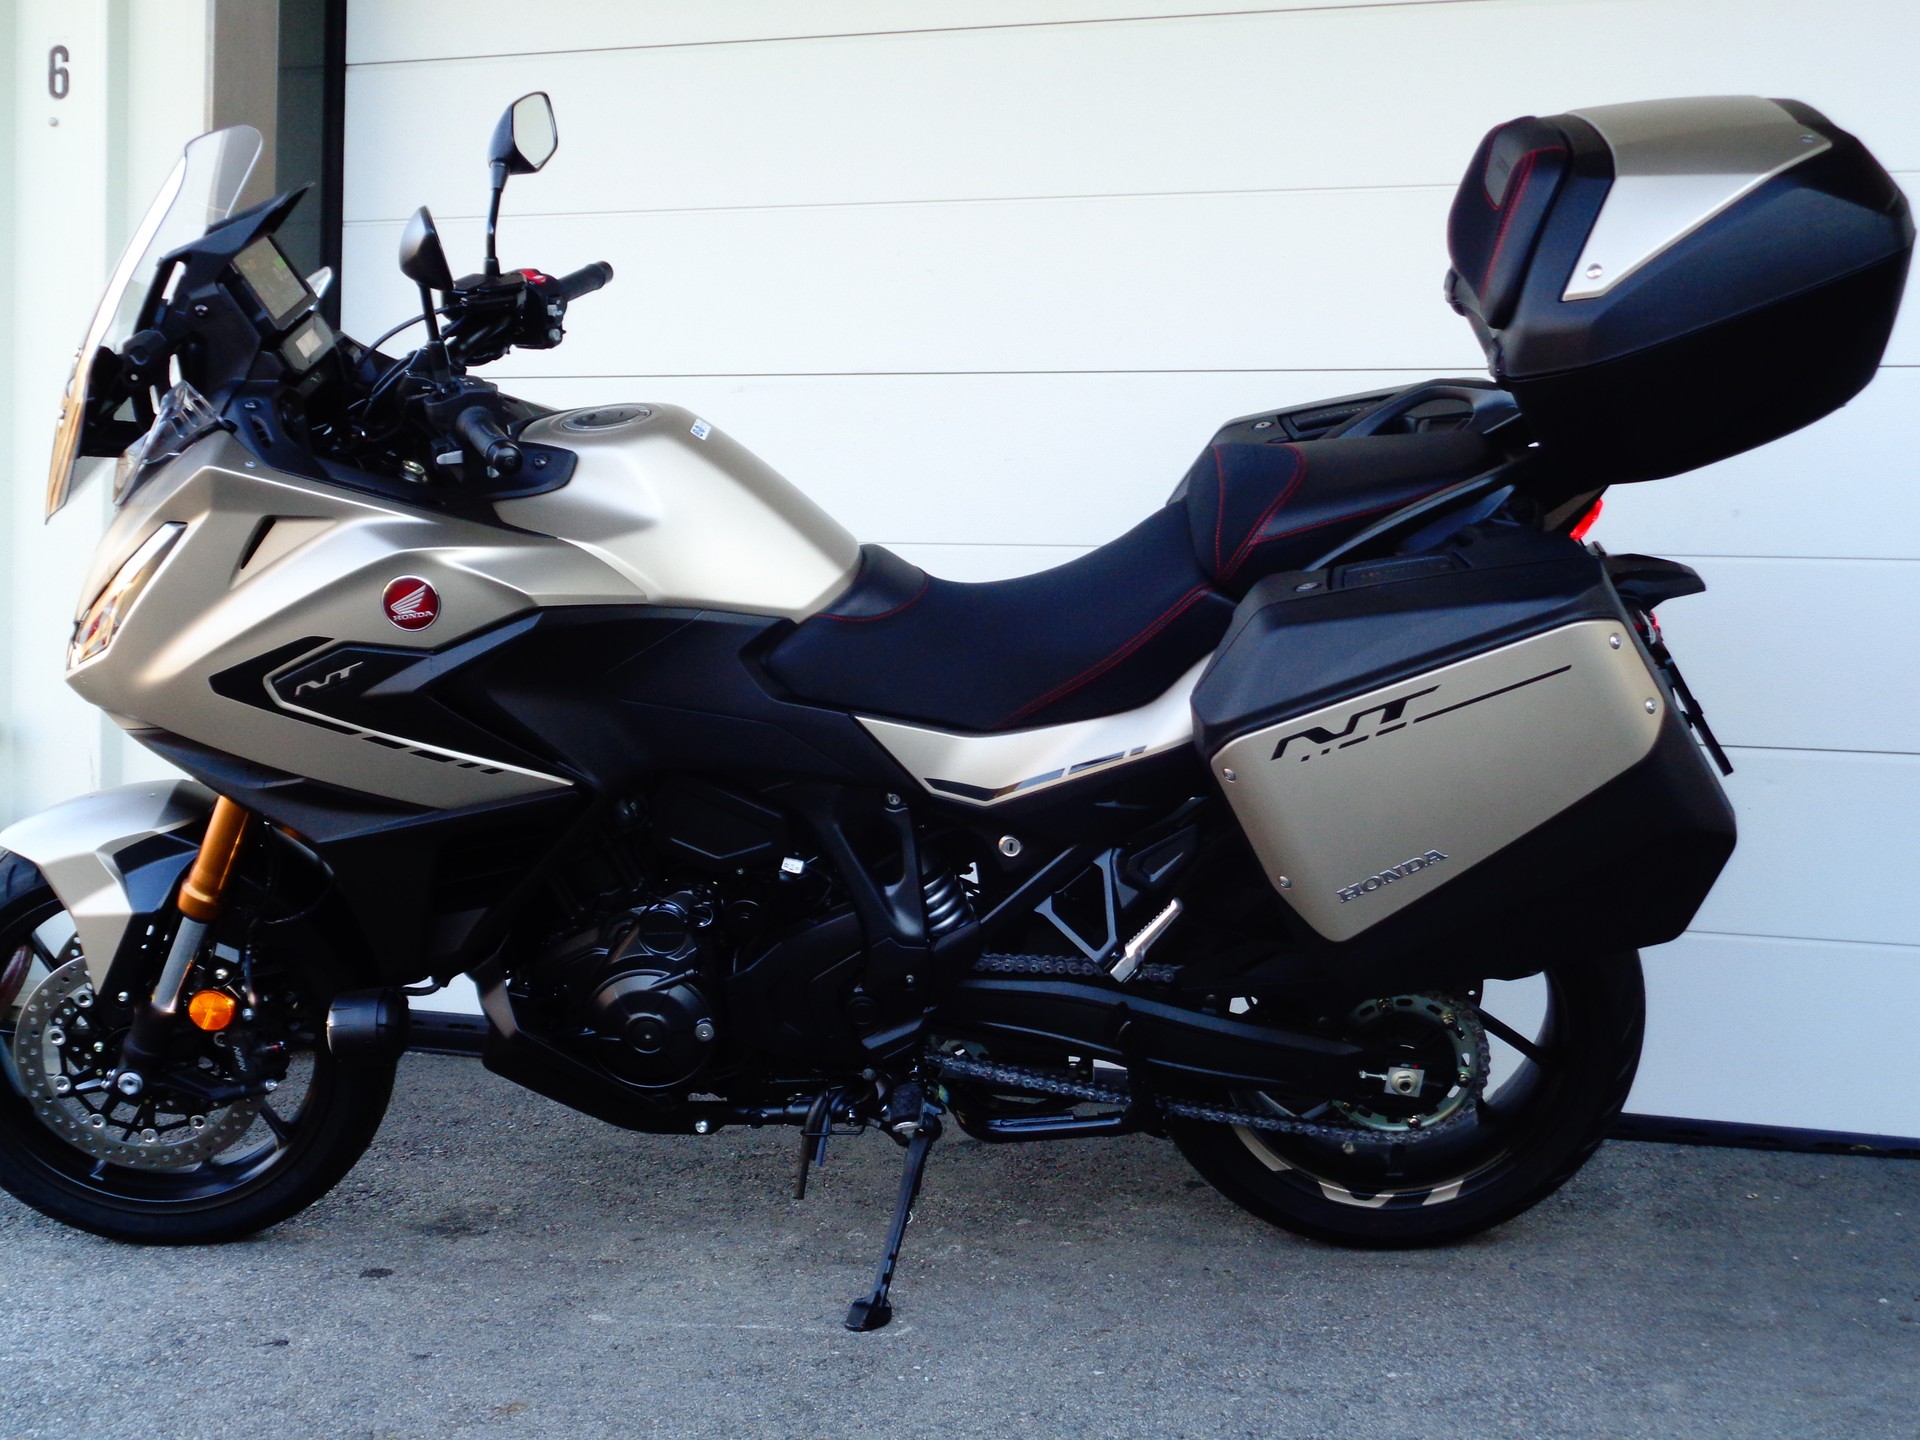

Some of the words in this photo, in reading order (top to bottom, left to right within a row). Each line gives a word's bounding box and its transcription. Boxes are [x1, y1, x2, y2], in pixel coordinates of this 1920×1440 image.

[49, 45, 69, 99] 6
[392, 610, 434, 621] HONDA
[1336, 849, 1449, 903] HONDA
